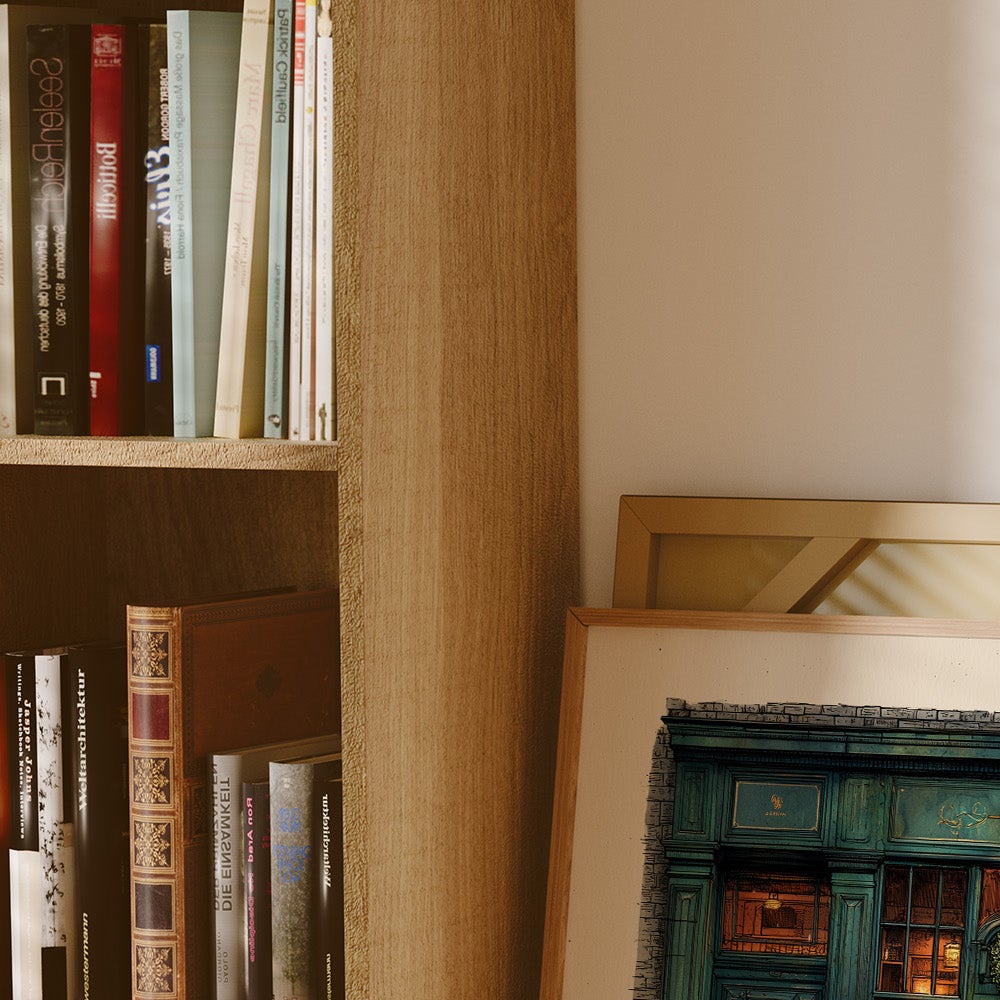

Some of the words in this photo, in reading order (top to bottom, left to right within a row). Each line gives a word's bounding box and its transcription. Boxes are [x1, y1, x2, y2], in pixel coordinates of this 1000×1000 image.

[23, 699, 32, 752] Jasper
[76, 669, 88, 811] Weltarchitektur
[25, 756, 33, 803] Johns
